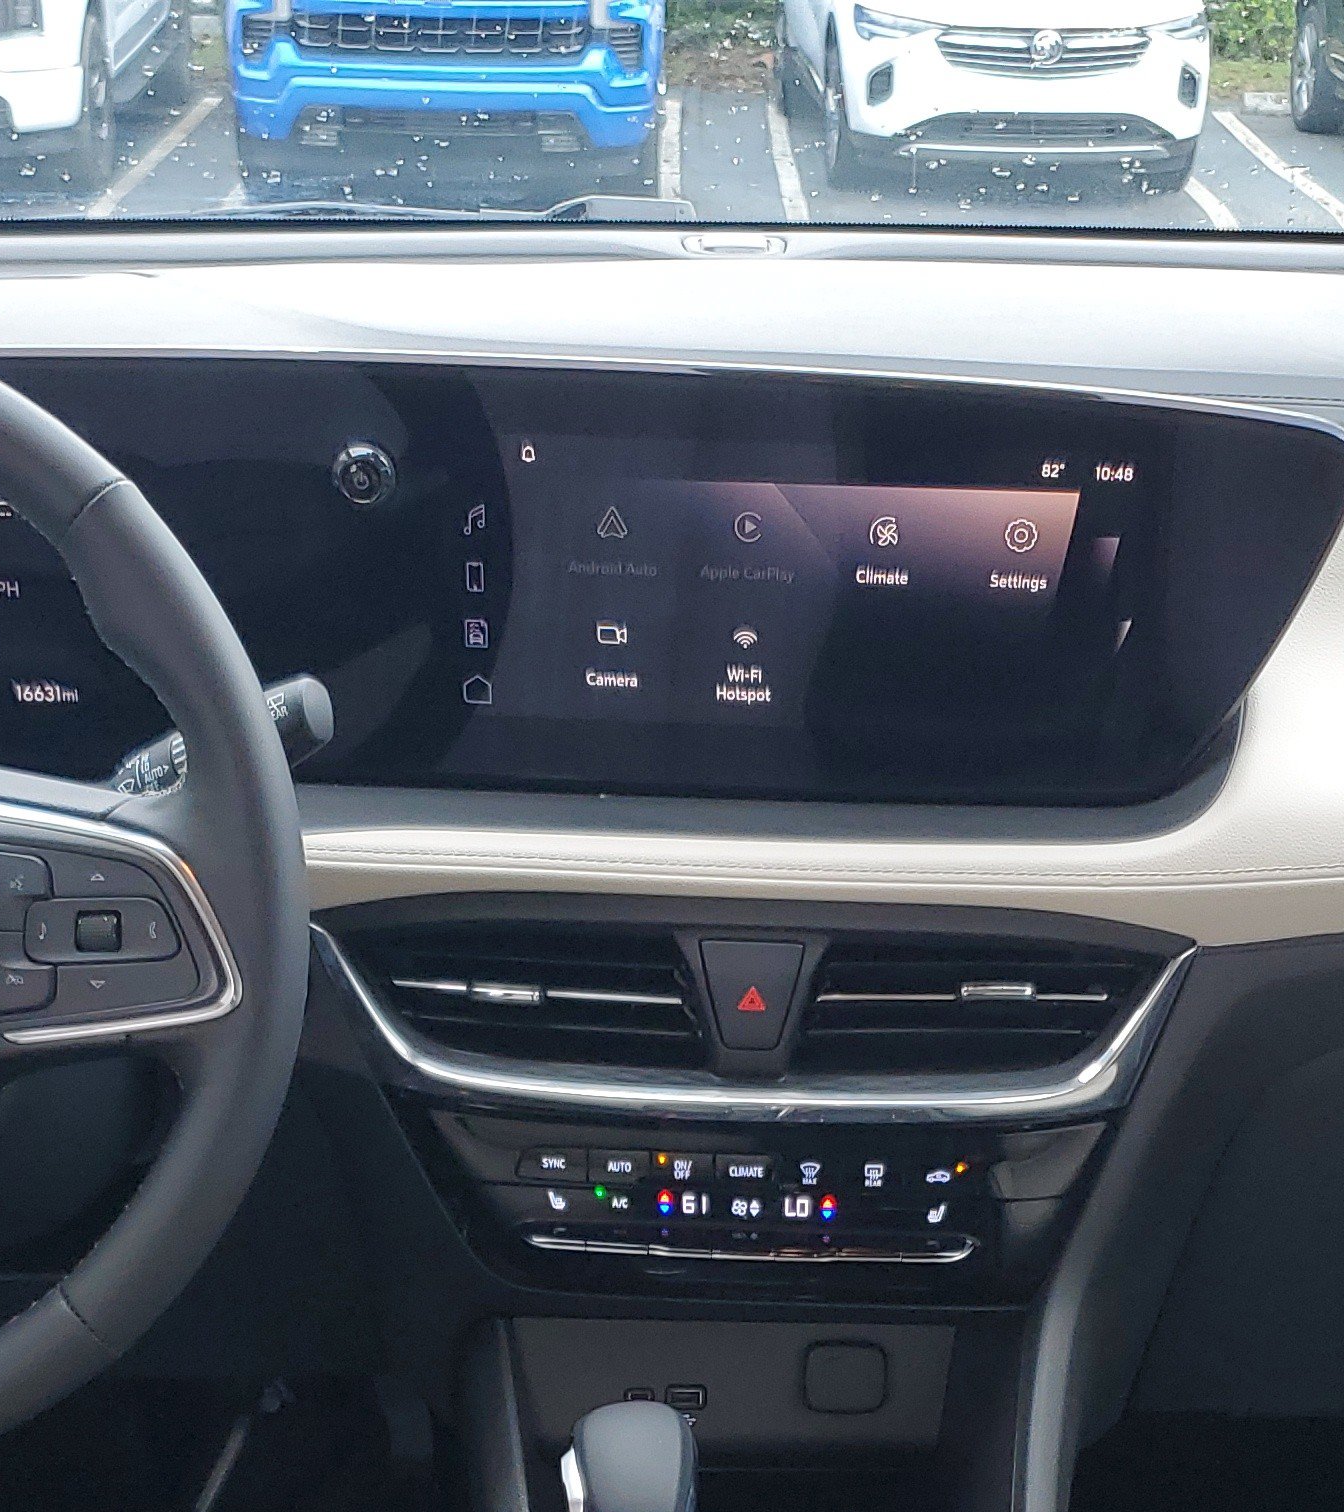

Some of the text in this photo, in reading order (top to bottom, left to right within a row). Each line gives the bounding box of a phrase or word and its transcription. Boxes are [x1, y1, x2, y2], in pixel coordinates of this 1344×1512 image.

[1094, 465, 1134, 482] 10:48
[568, 560, 657, 577] Android Auto
[700, 565, 795, 583] Apple CarPlay
[856, 567, 908, 585] Climate
[989, 573, 1047, 592] Settings
[586, 671, 638, 687] Camera
[726, 666, 762, 683] Wi-Fi
[716, 684, 771, 704] Hotspot
[541, 1157, 566, 1170] SYNC
[607, 1160, 632, 1173] AUTO
[729, 1165, 764, 1178] CLIMATE
